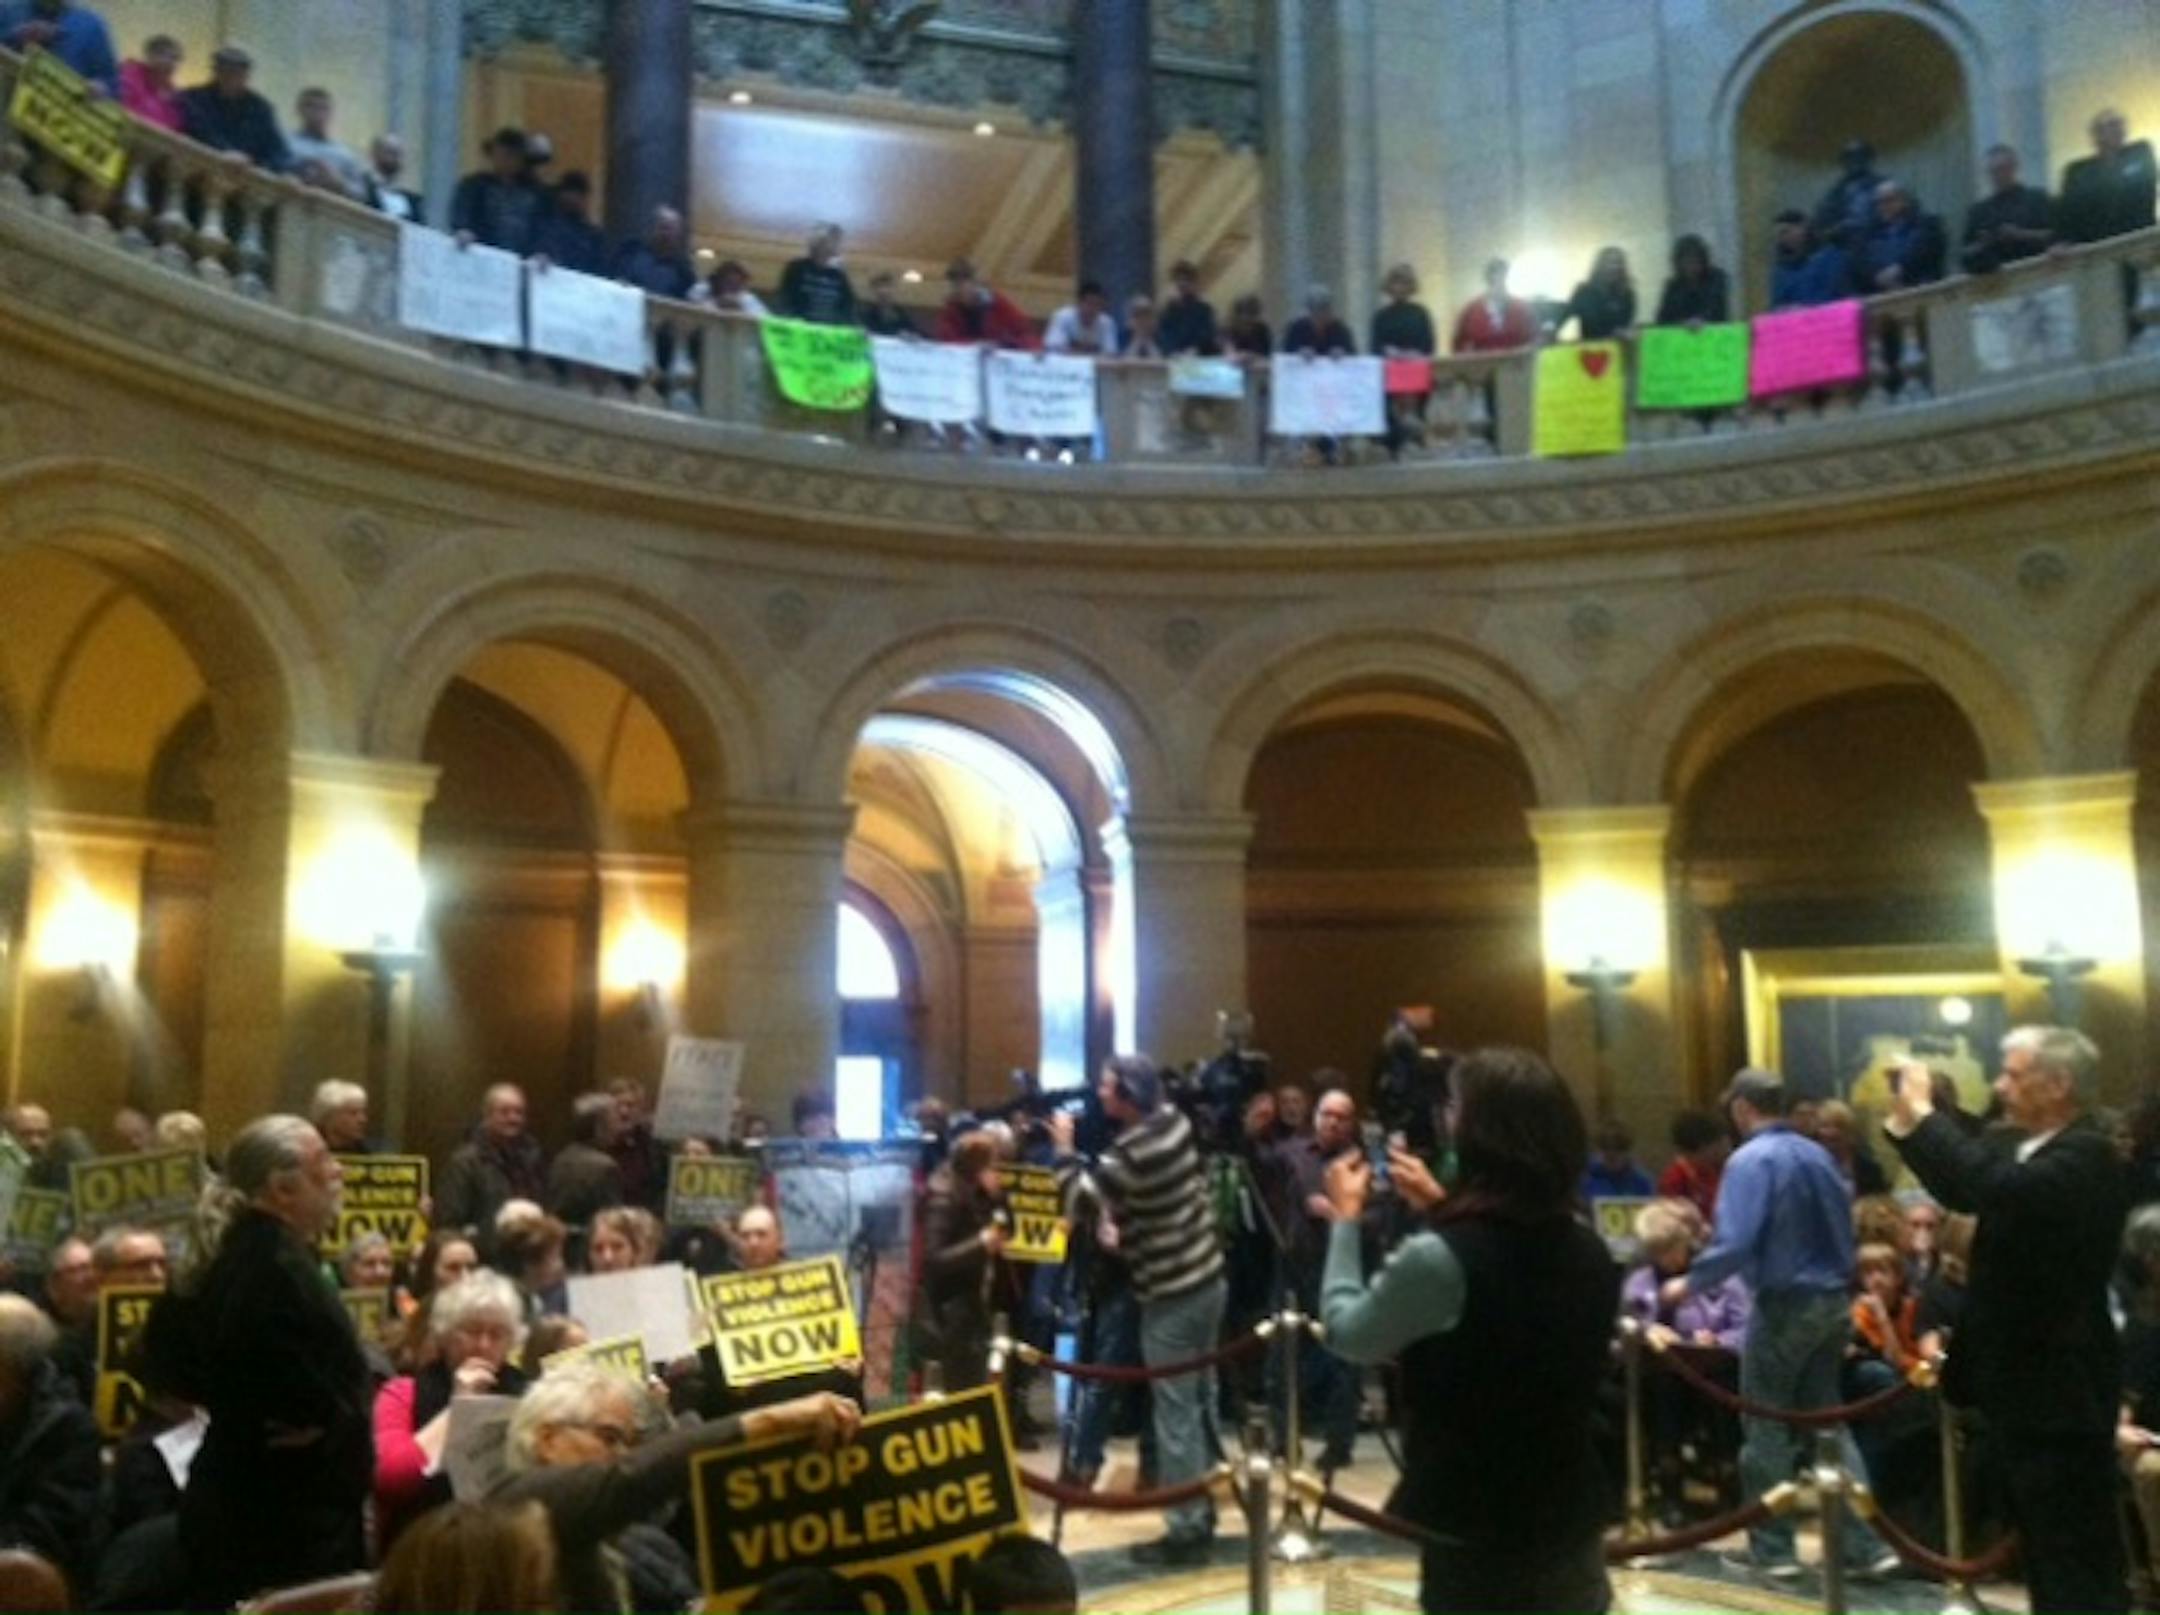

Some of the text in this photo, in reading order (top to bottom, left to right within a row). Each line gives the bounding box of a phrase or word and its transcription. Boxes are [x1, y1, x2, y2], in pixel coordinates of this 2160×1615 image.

[83, 1156, 193, 1211] ONE
[716, 1261, 831, 1303] STOP GUN
[723, 1288, 836, 1326] VIOLENCE
[729, 1319, 843, 1367] NOW
[725, 1414, 984, 1511] STOP GUN
[729, 1471, 997, 1569] VIOLENCE
